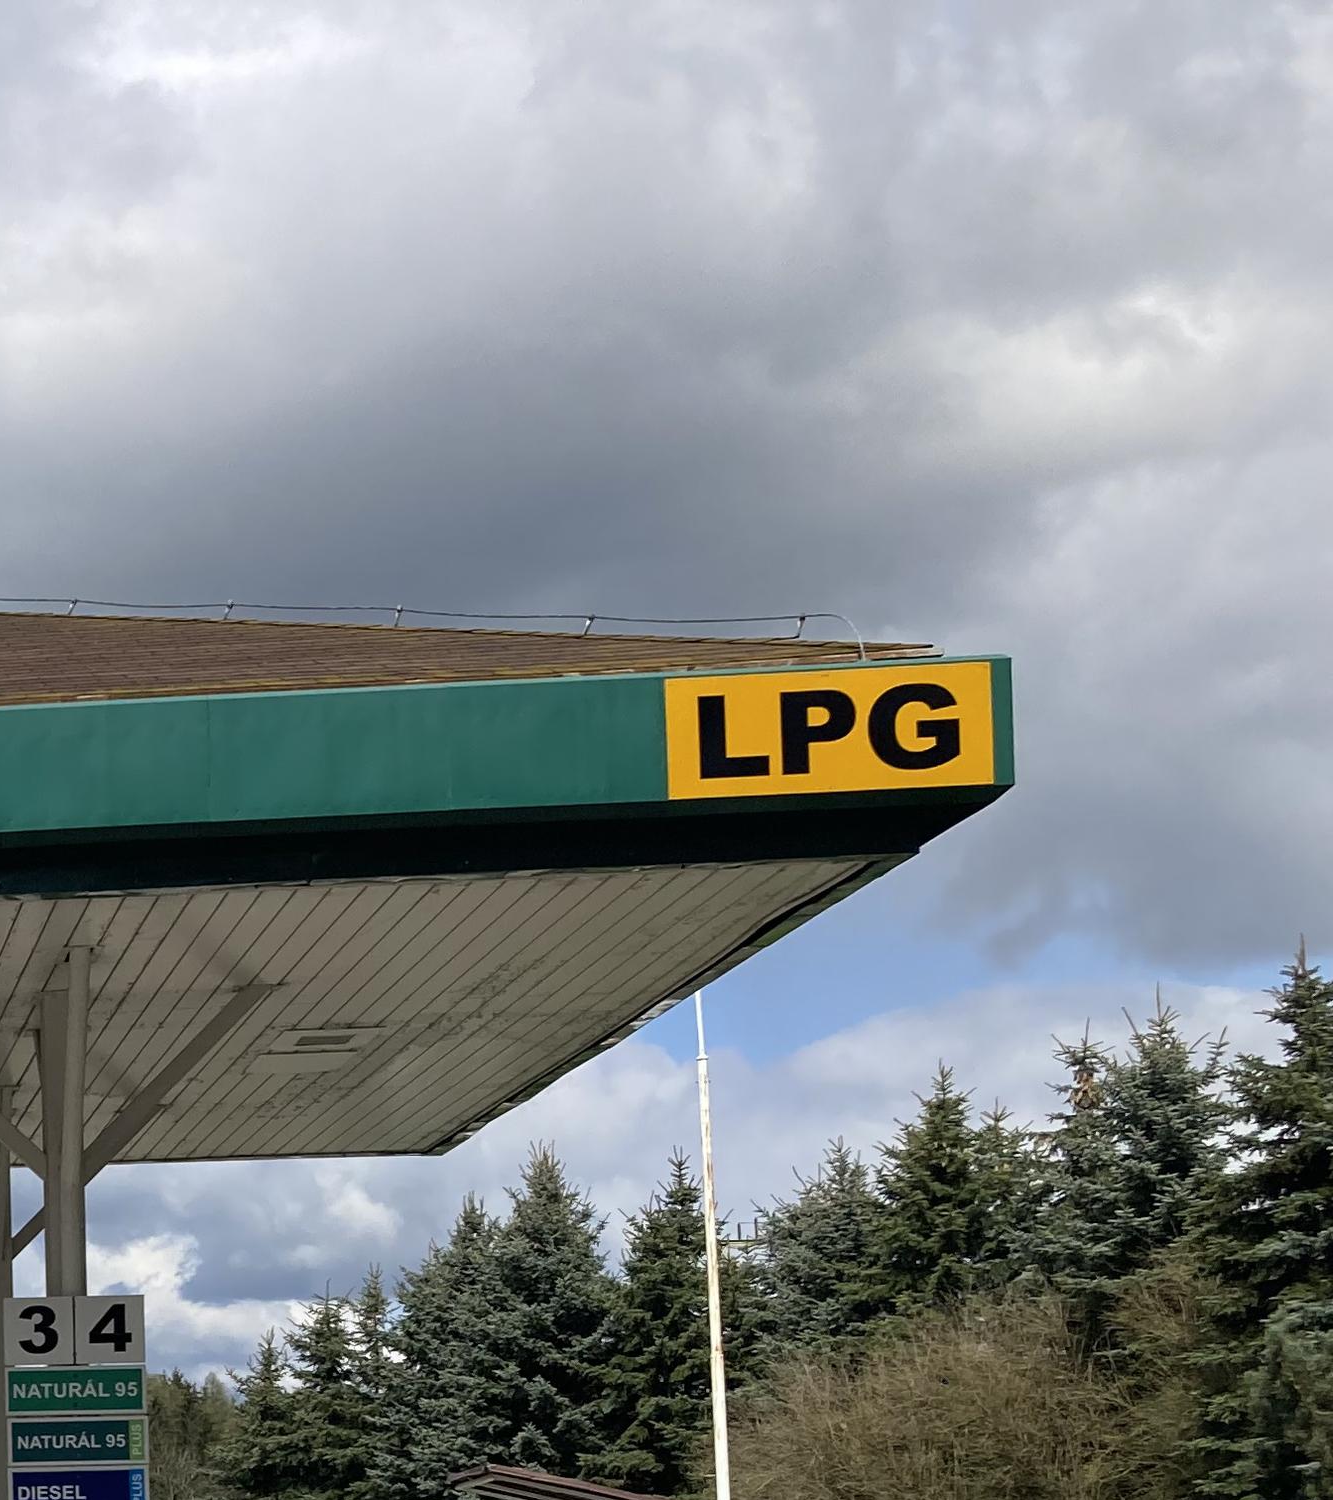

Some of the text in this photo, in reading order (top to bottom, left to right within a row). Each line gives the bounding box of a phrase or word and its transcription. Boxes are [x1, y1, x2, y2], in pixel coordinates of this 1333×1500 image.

[697, 683, 960, 779] LPG
[18, 1304, 132, 1354] 3 4
[12, 1380, 138, 1398] NATURÁL 95
[17, 1424, 142, 1455] NATURÁL 95 PLUS
[17, 1485, 87, 1500] DIESEL
